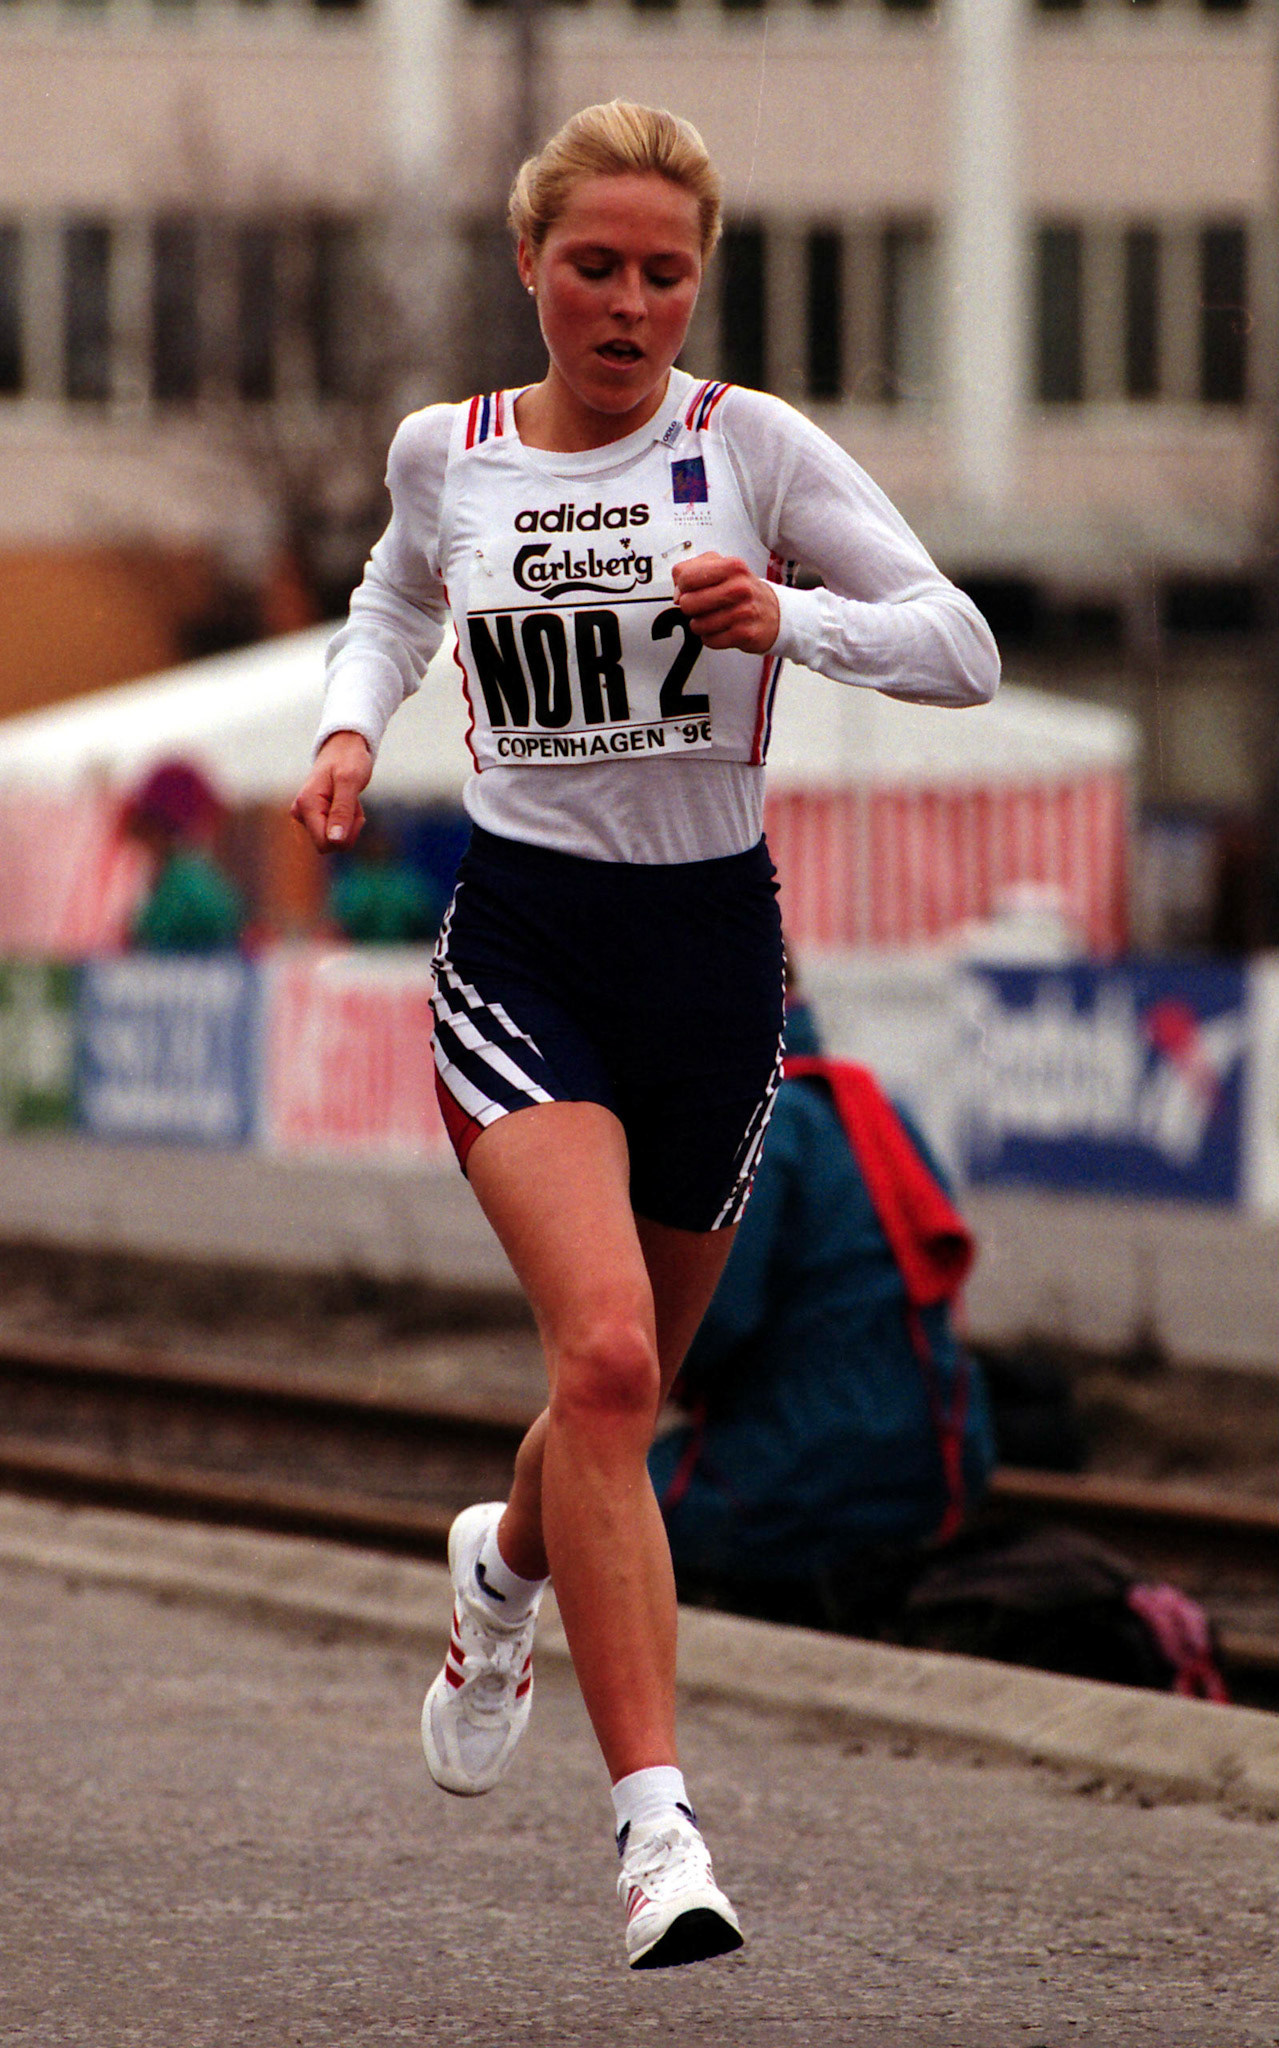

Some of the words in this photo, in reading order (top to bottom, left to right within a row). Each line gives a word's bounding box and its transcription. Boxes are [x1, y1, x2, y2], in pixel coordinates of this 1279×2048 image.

[662, 420, 678, 442] ODLO
[514, 503, 649, 533] adidas
[513, 543, 653, 590] Carlsberg
[467, 609, 630, 728] NOR
[651, 607, 710, 718] 2
[497, 729, 665, 756] COPENHAGEN
